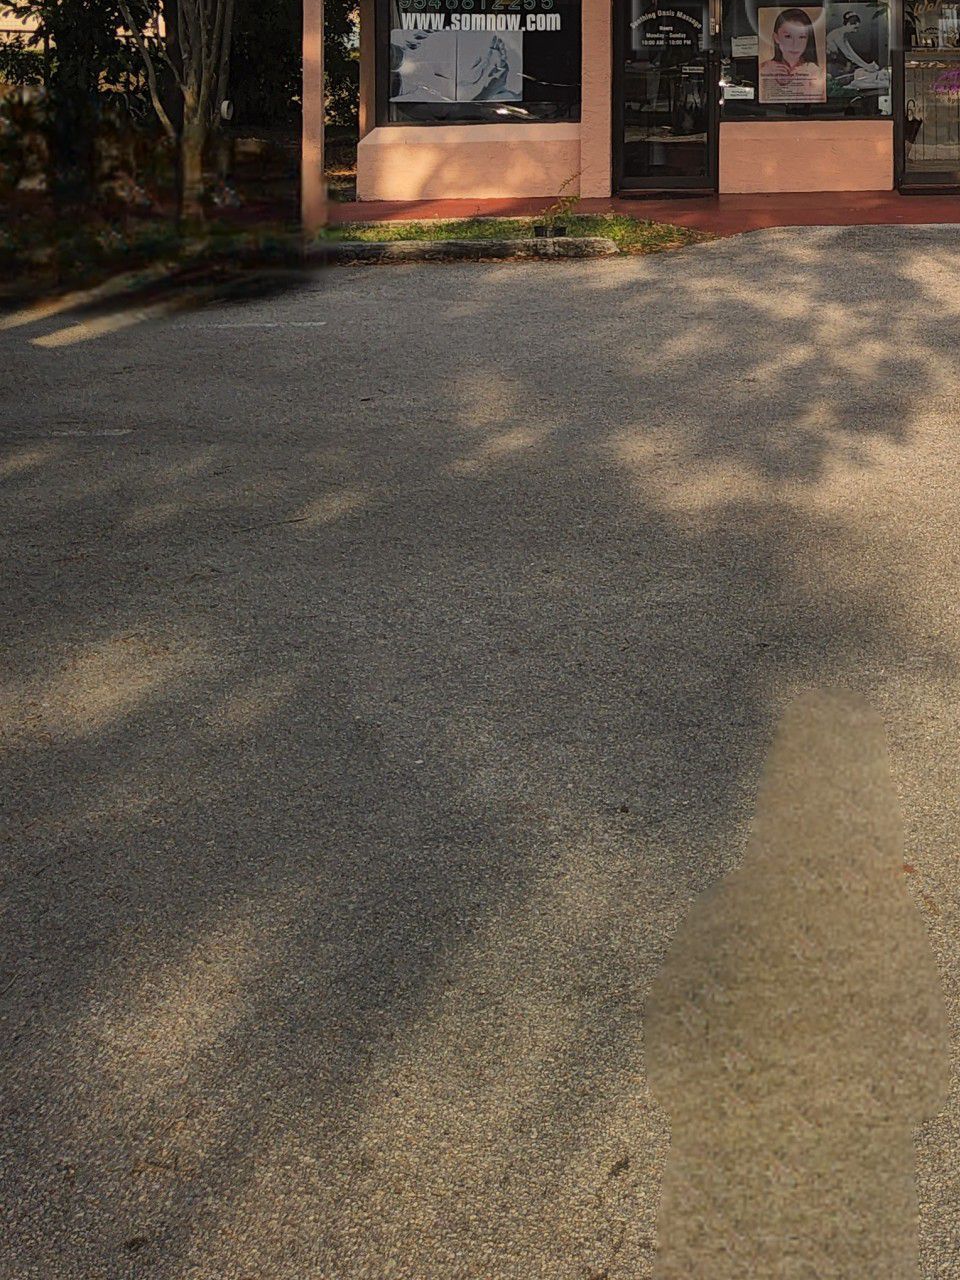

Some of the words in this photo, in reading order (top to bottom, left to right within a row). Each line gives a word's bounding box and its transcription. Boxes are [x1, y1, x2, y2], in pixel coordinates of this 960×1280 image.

[401, 13, 561, 32] www.somnow.com
[657, 9, 675, 17] Oasis
[676, 10, 702, 29] Massage
